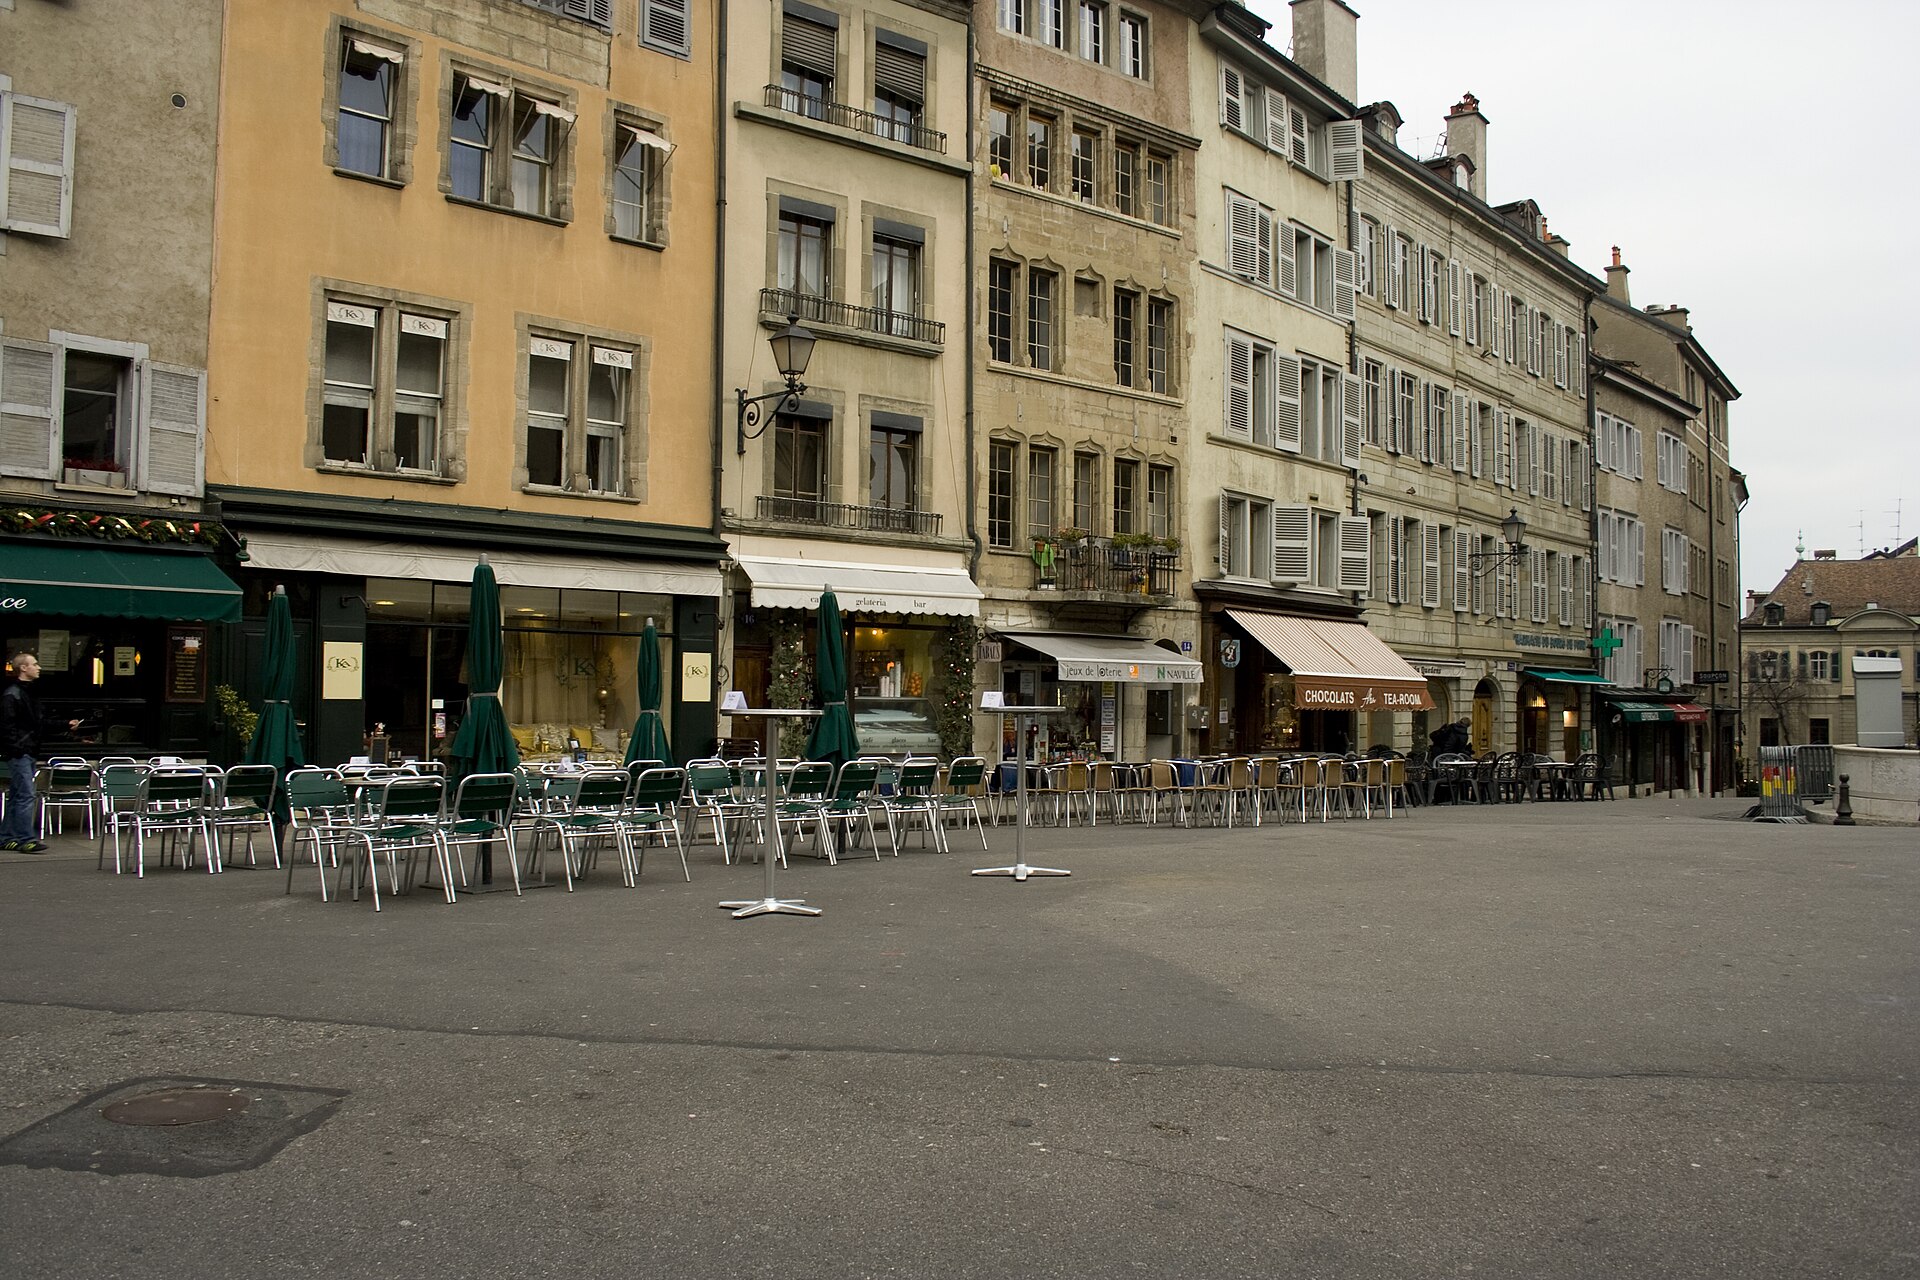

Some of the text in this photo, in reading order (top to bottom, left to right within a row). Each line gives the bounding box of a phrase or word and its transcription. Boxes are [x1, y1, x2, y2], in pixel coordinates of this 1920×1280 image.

[855, 597, 887, 607] gelateria
[913, 599, 926, 608] bar
[1183, 642, 1191, 651] 14
[1066, 666, 1083, 678] jeux
[1085, 665, 1094, 676] de
[1096, 665, 1122, 678] loterie
[1166, 669, 1196, 680] NAVILLE
[1305, 689, 1355, 704] CHOCOLATS
[1383, 692, 1422, 705] TEA-ROOM
